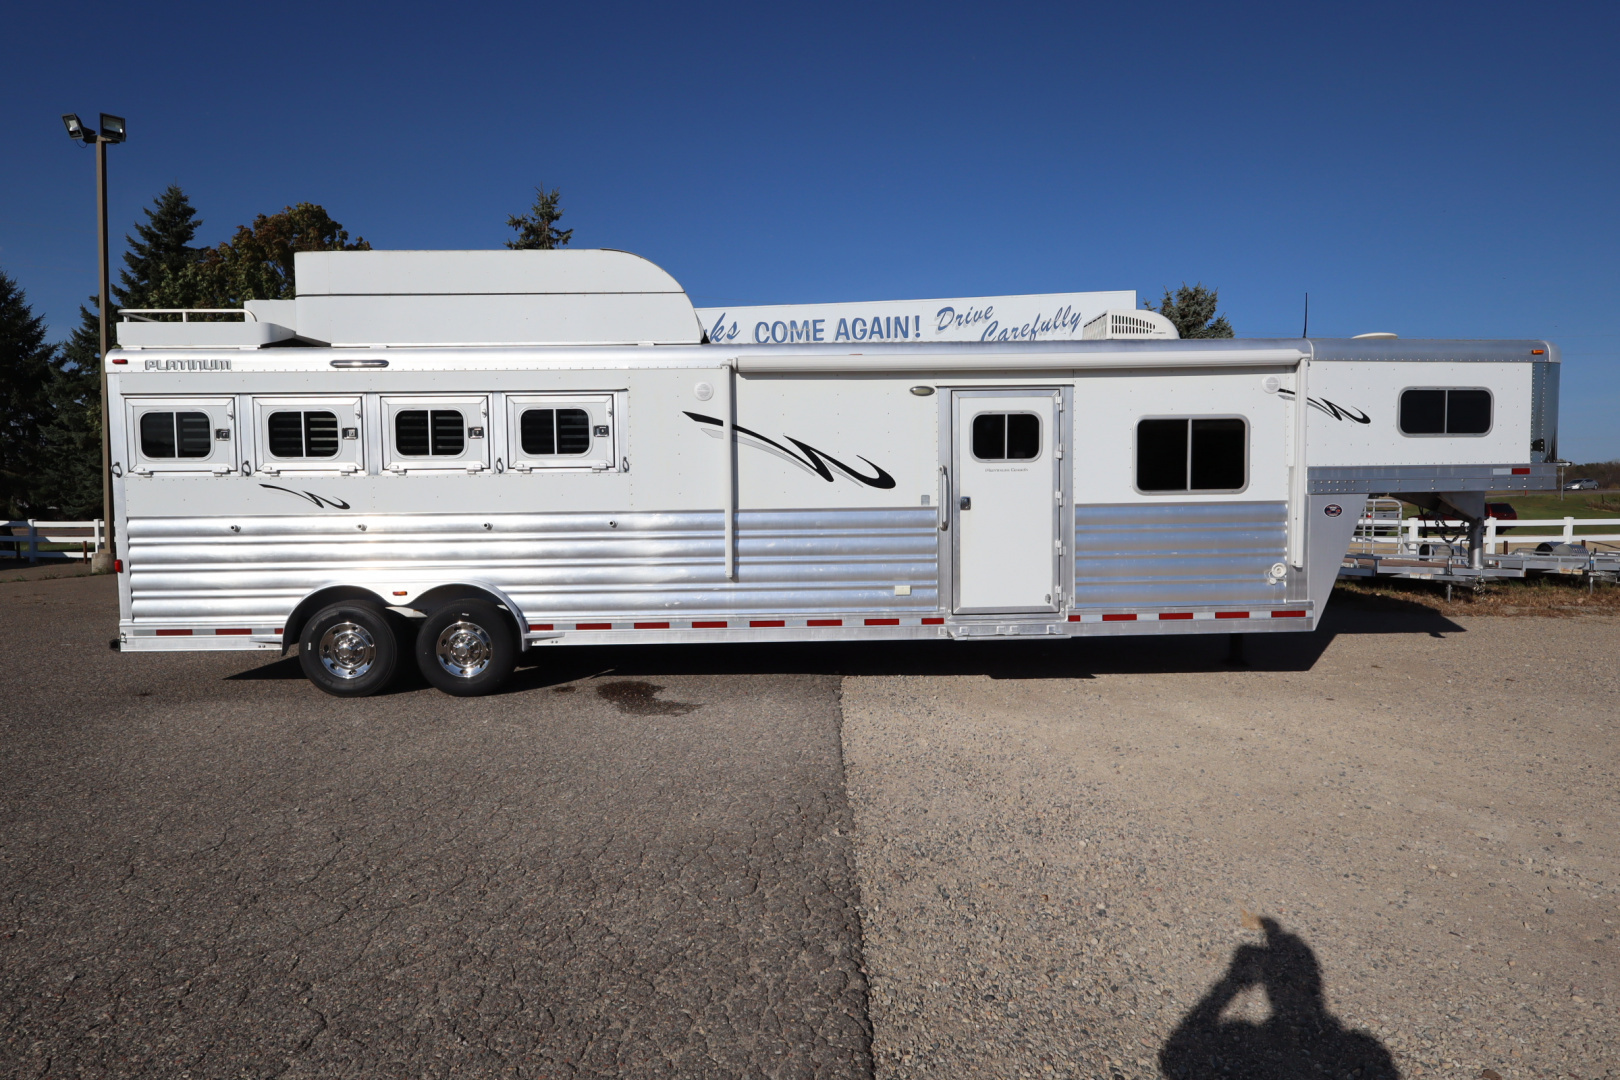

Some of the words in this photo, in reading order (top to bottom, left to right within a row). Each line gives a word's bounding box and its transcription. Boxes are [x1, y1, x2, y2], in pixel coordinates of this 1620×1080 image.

[704, 312, 741, 343] ks
[754, 318, 825, 343] COME
[835, 315, 921, 341] AGAIN!
[936, 305, 994, 331] Drive
[980, 305, 1083, 341] Carefully
[144, 359, 232, 371] PLATINUM
